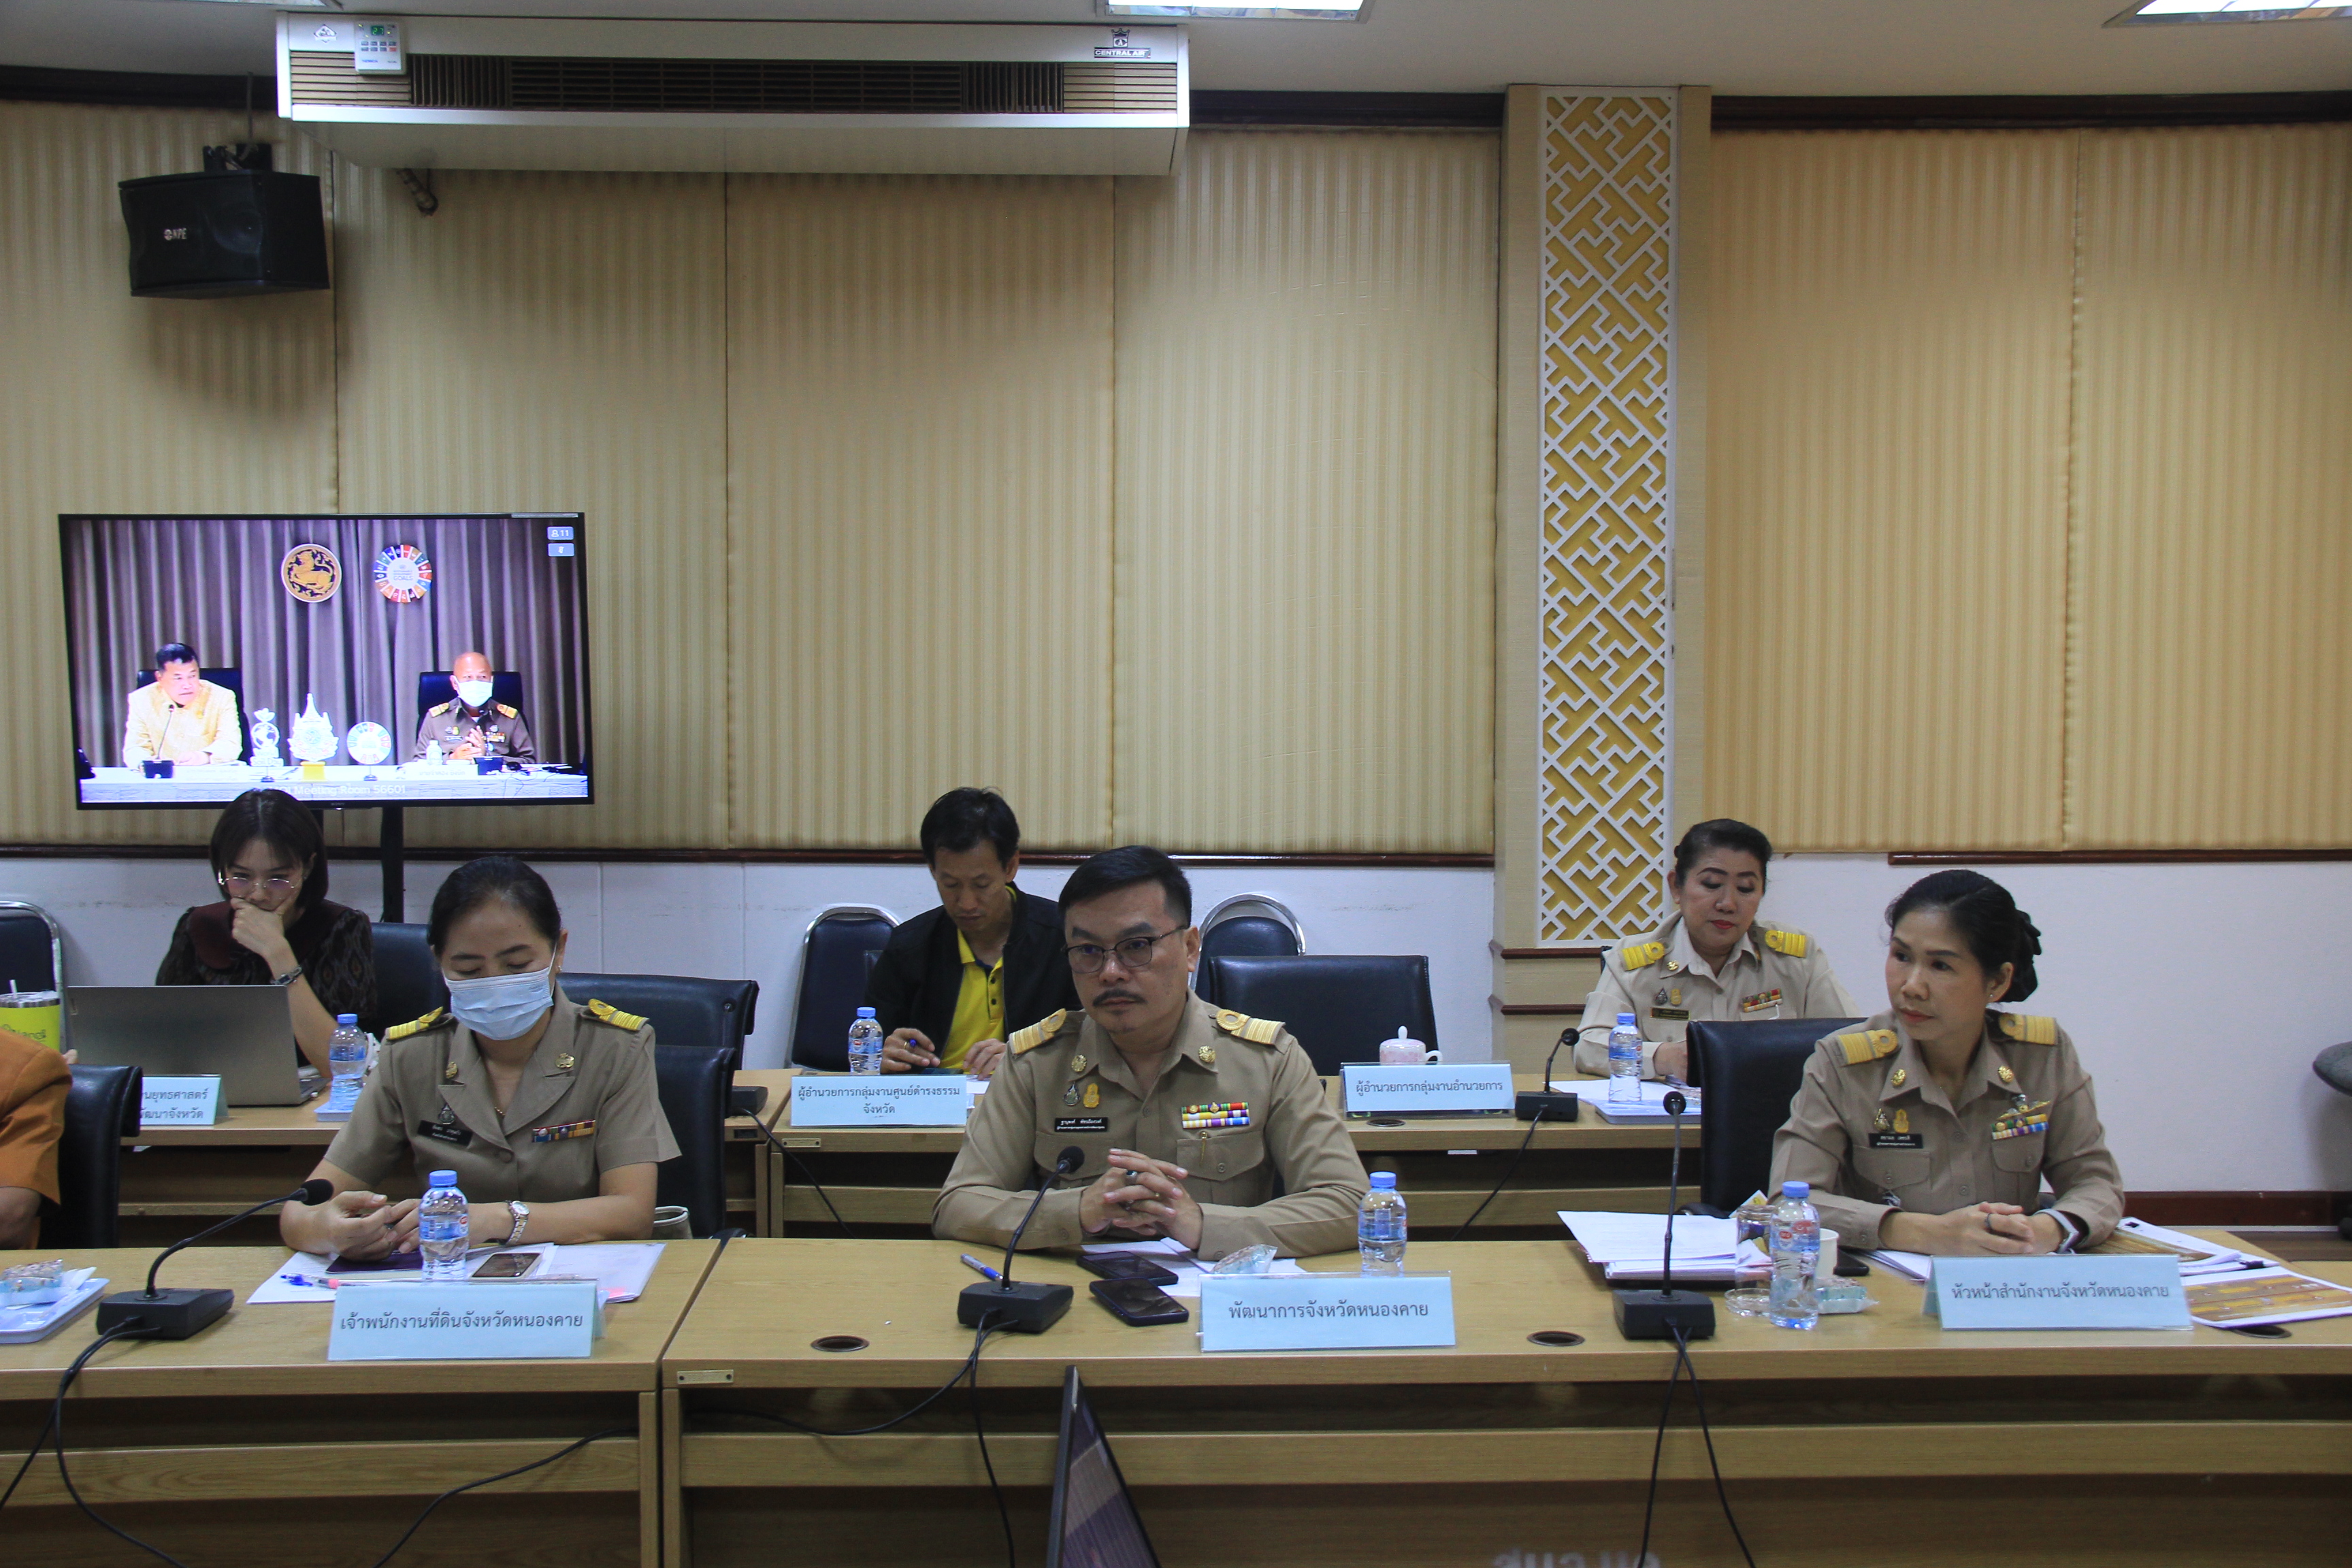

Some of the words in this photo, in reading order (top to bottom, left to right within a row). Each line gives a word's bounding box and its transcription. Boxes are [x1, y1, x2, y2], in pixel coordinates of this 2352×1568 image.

[372, 27, 384, 35] 27
[295, 785, 338, 796] Meeting
[340, 785, 371, 794] Room
[374, 785, 406, 794] 56601
[142, 1087, 210, 1103] นยุทธศาสตร์
[798, 1084, 960, 1100] ผู้อำนวยการกลุ่มงานศูนย์ดำรงธรรม
[1355, 1079, 1503, 1096] ผู้อำนวยการกลุ่มงานอำนวยการ
[863, 1102, 896, 1114] จังหวัด
[1951, 1280, 2169, 1299] หัวหน้าสำนักงานจังหวัดหนองคาย
[1228, 1298, 1428, 1318] พัฒนาการจังหวัดหนองคาย
[340, 1307, 584, 1330] เจ้าพนักงานที่ดินจังหวัดหนองคาย
